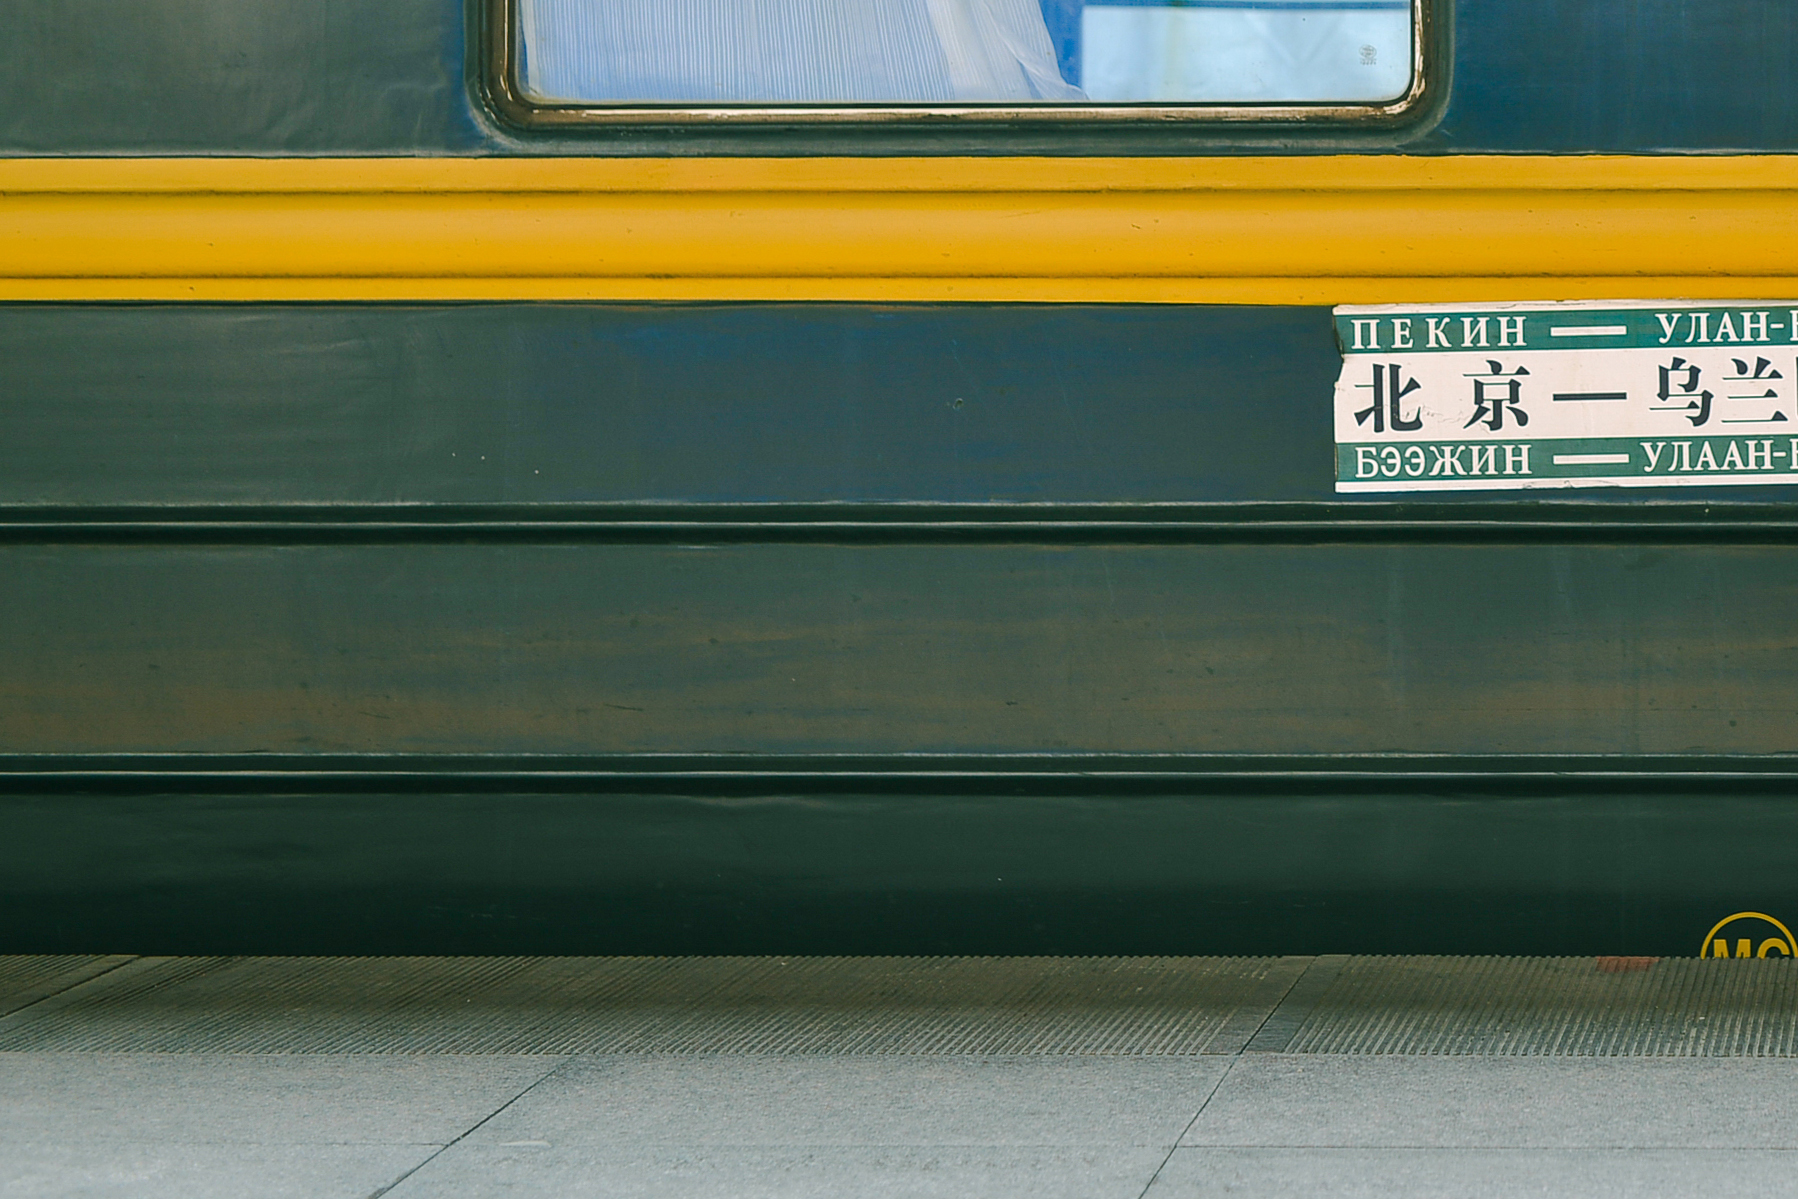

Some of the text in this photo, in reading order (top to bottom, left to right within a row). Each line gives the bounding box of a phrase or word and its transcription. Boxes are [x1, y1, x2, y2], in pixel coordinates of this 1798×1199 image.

[1350, 316, 1527, 349] ПЕКИН
[1353, 359, 1531, 433] 北京
[1355, 444, 1533, 479] БЭЭЖИН
